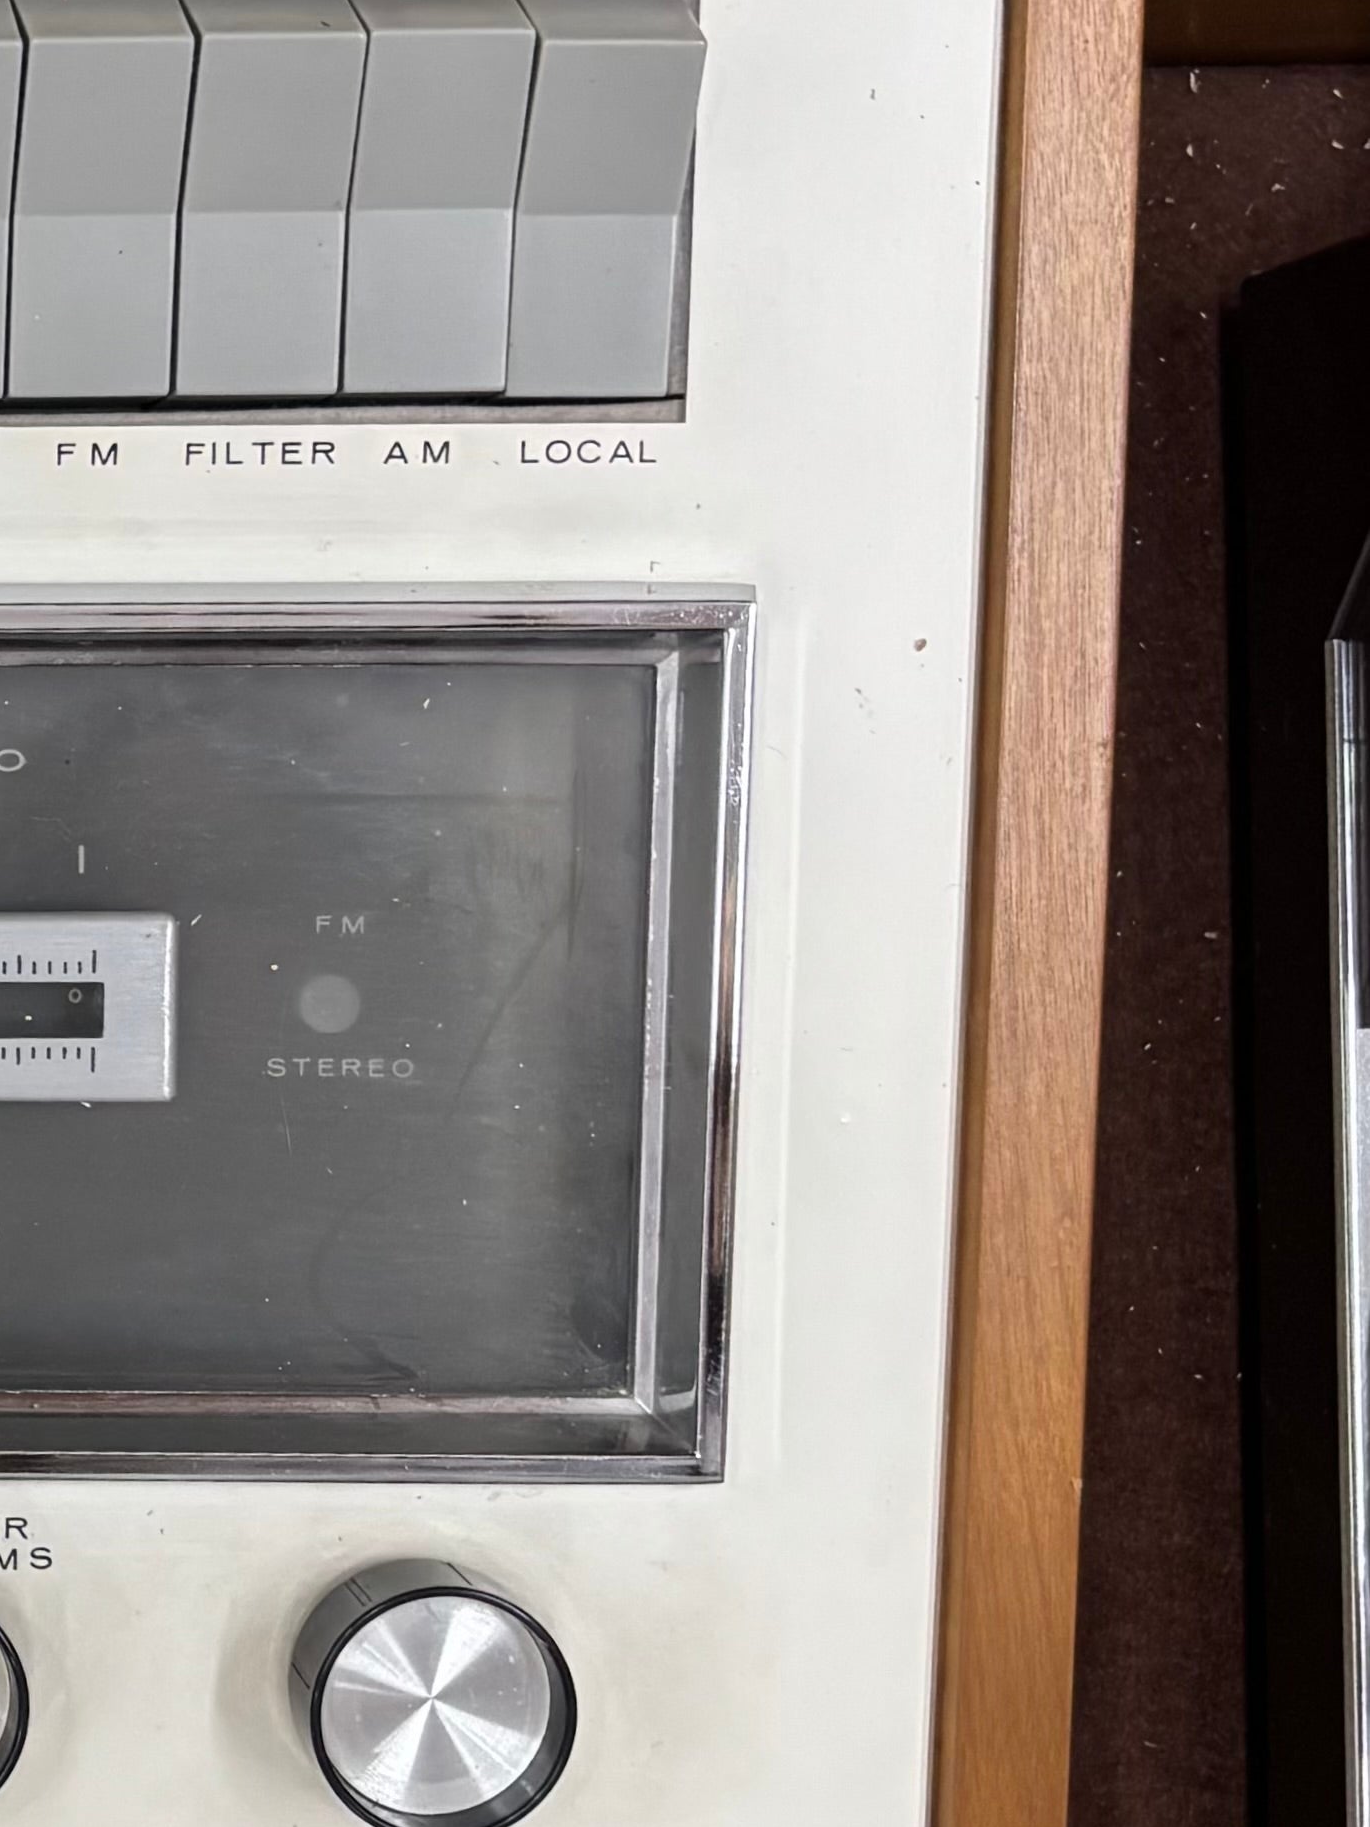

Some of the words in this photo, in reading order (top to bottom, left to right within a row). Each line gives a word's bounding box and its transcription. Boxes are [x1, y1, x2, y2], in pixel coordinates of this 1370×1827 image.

[57, 442, 118, 466] FM
[185, 441, 336, 466] FILTER
[383, 440, 450, 465] AM
[520, 439, 657, 464] LOCAL
[316, 915, 365, 934] FM
[68, 988, 83, 1004] 0
[267, 1057, 414, 1078] STEREO
